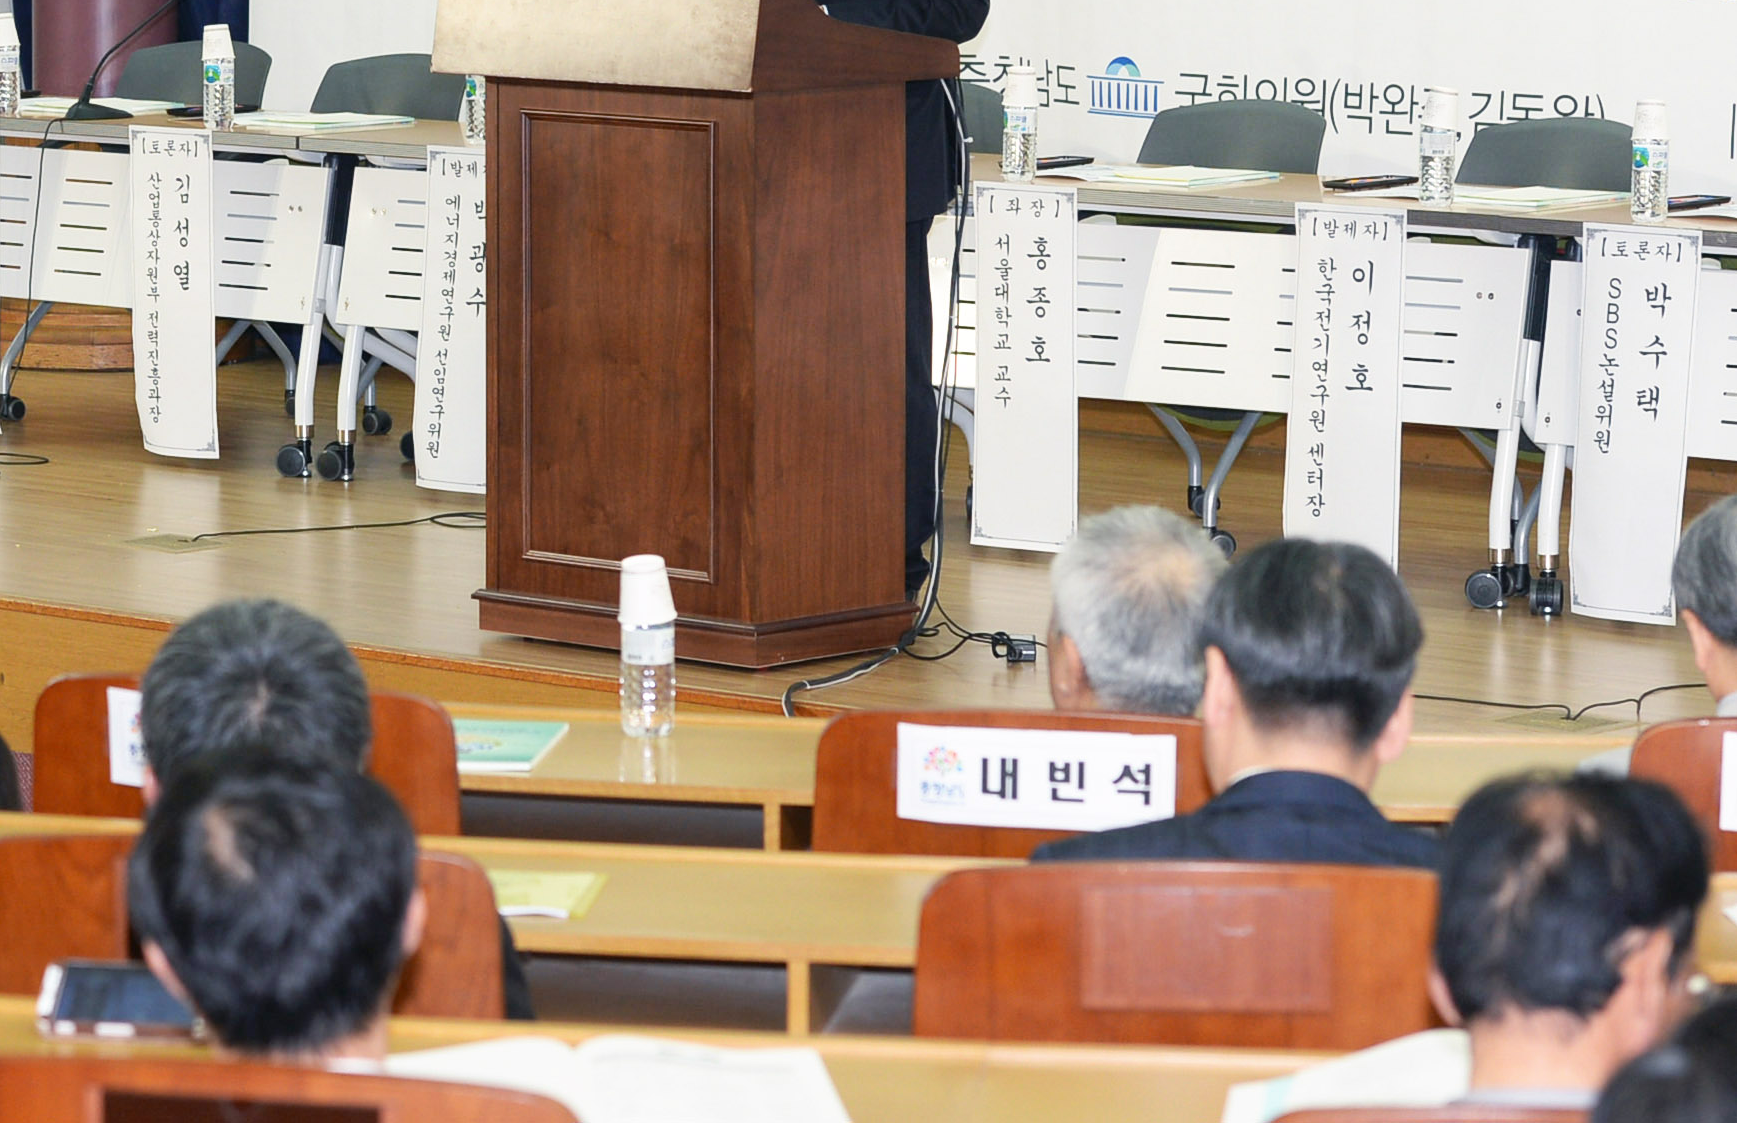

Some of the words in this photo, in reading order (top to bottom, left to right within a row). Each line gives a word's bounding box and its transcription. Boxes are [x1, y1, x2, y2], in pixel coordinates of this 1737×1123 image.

[441, 158, 485, 178] [발제
[146, 171, 162, 303] 산업통상자원부
[173, 174, 191, 291] 김성열
[438, 194, 461, 342] 에너지경제연구원
[993, 233, 1013, 351] 서울대학교
[1025, 236, 1052, 363] 홍종호
[1309, 257, 1337, 433] 한국전기연구원
[1345, 260, 1374, 392] 이정호
[147, 310, 162, 424] 전력진흥과장
[426, 348, 448, 459] 선임연구위원
[993, 365, 1012, 408] 교수
[1636, 282, 1672, 421] 박수택
[1306, 442, 1326, 518] 센터장
[982, 757, 1152, 806] 내빈석
